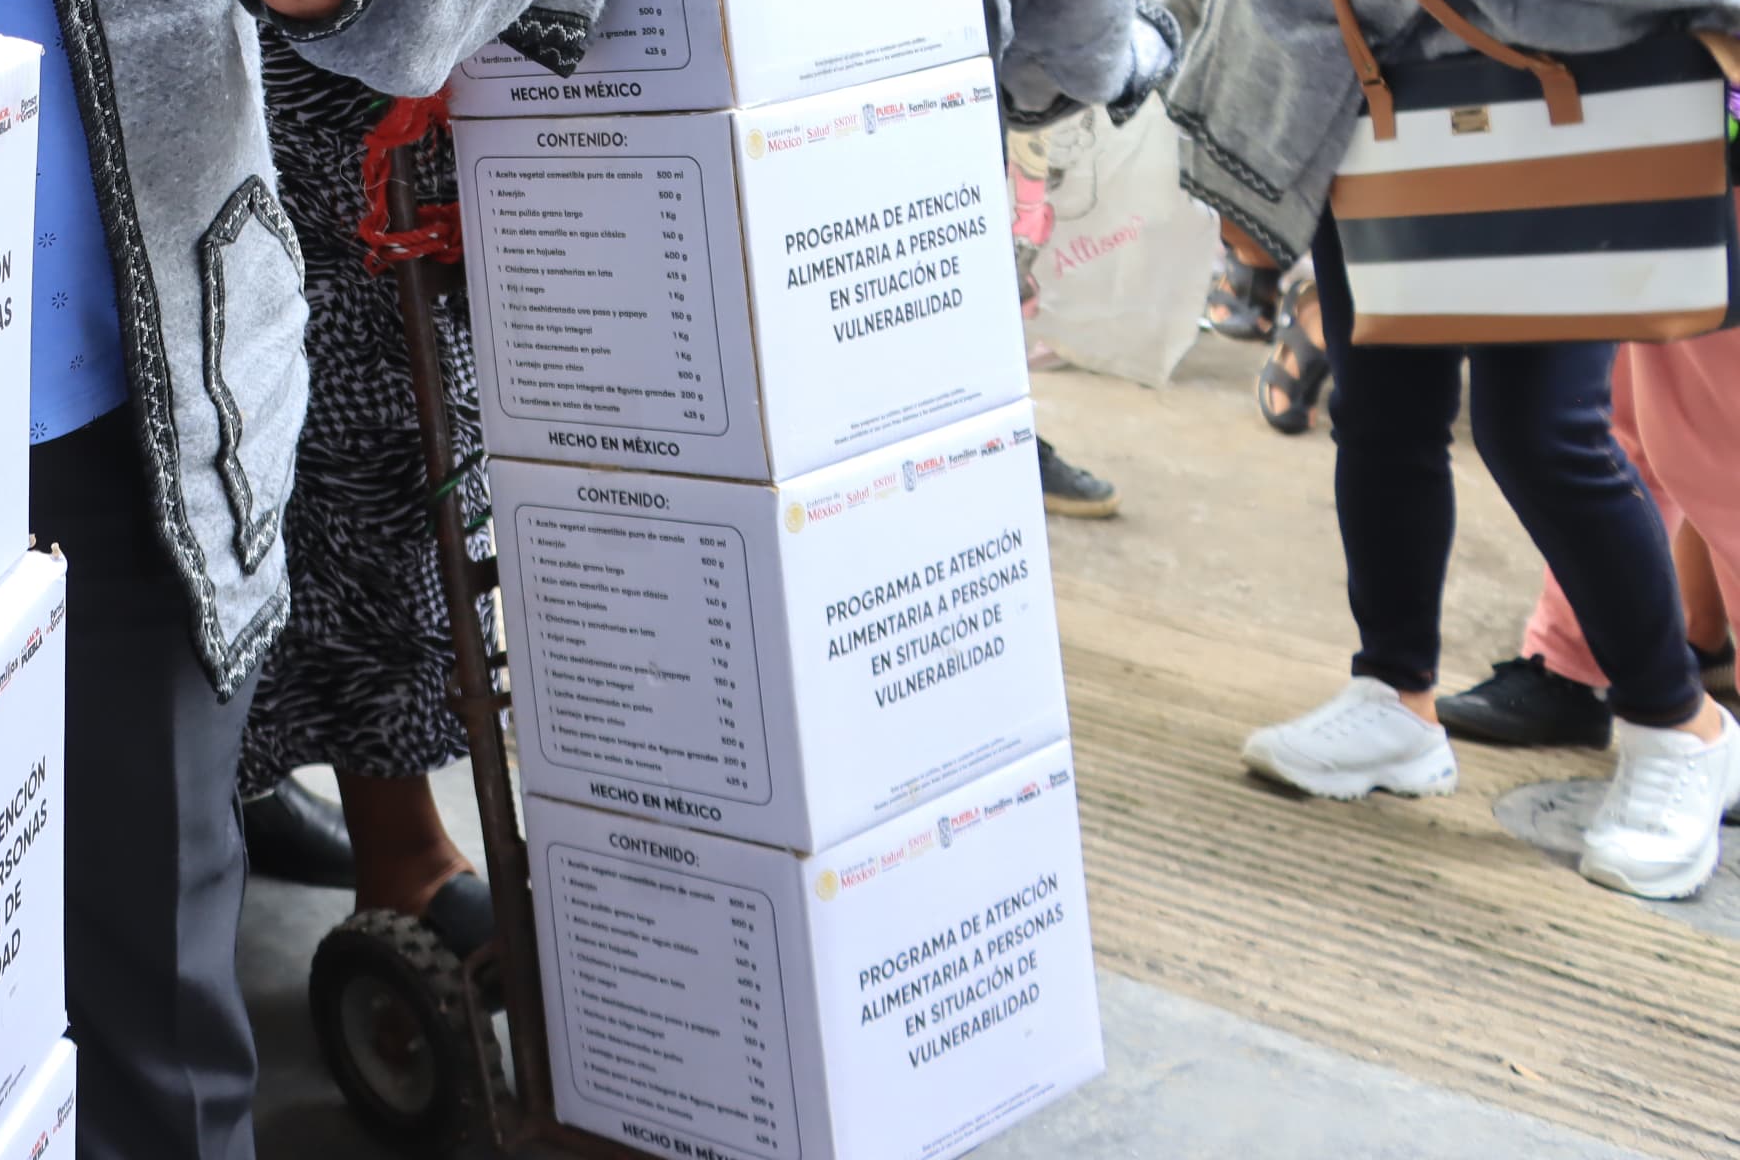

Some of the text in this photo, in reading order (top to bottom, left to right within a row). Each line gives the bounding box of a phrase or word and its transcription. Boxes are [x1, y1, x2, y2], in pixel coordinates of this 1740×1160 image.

[510, 80, 642, 101] HECHO EN MÉXICO
[536, 131, 628, 148] CONTENIDO:
[767, 100, 938, 153] México Salud PUEBLA Familias
[785, 186, 981, 255] PROGRAMA DE ATENCIÓN
[787, 215, 987, 290] ALIMENTARIA A PERSONAS
[829, 255, 959, 311] EN SITUACIÓN DE
[833, 288, 963, 343] VULNERABILIDAD
[577, 486, 670, 510] CONTENIDO:
[826, 530, 1022, 625] PROGRAMA DE ATENCIÓN
[828, 559, 1028, 660] ALIMENTARIA A PERSONAS
[20, 635, 44, 669] PUEBLA
[871, 604, 1002, 676] EN SITUACIÓN DE
[875, 636, 1005, 708] VULNERABILIDAD
[4, 879, 22, 925] DE
